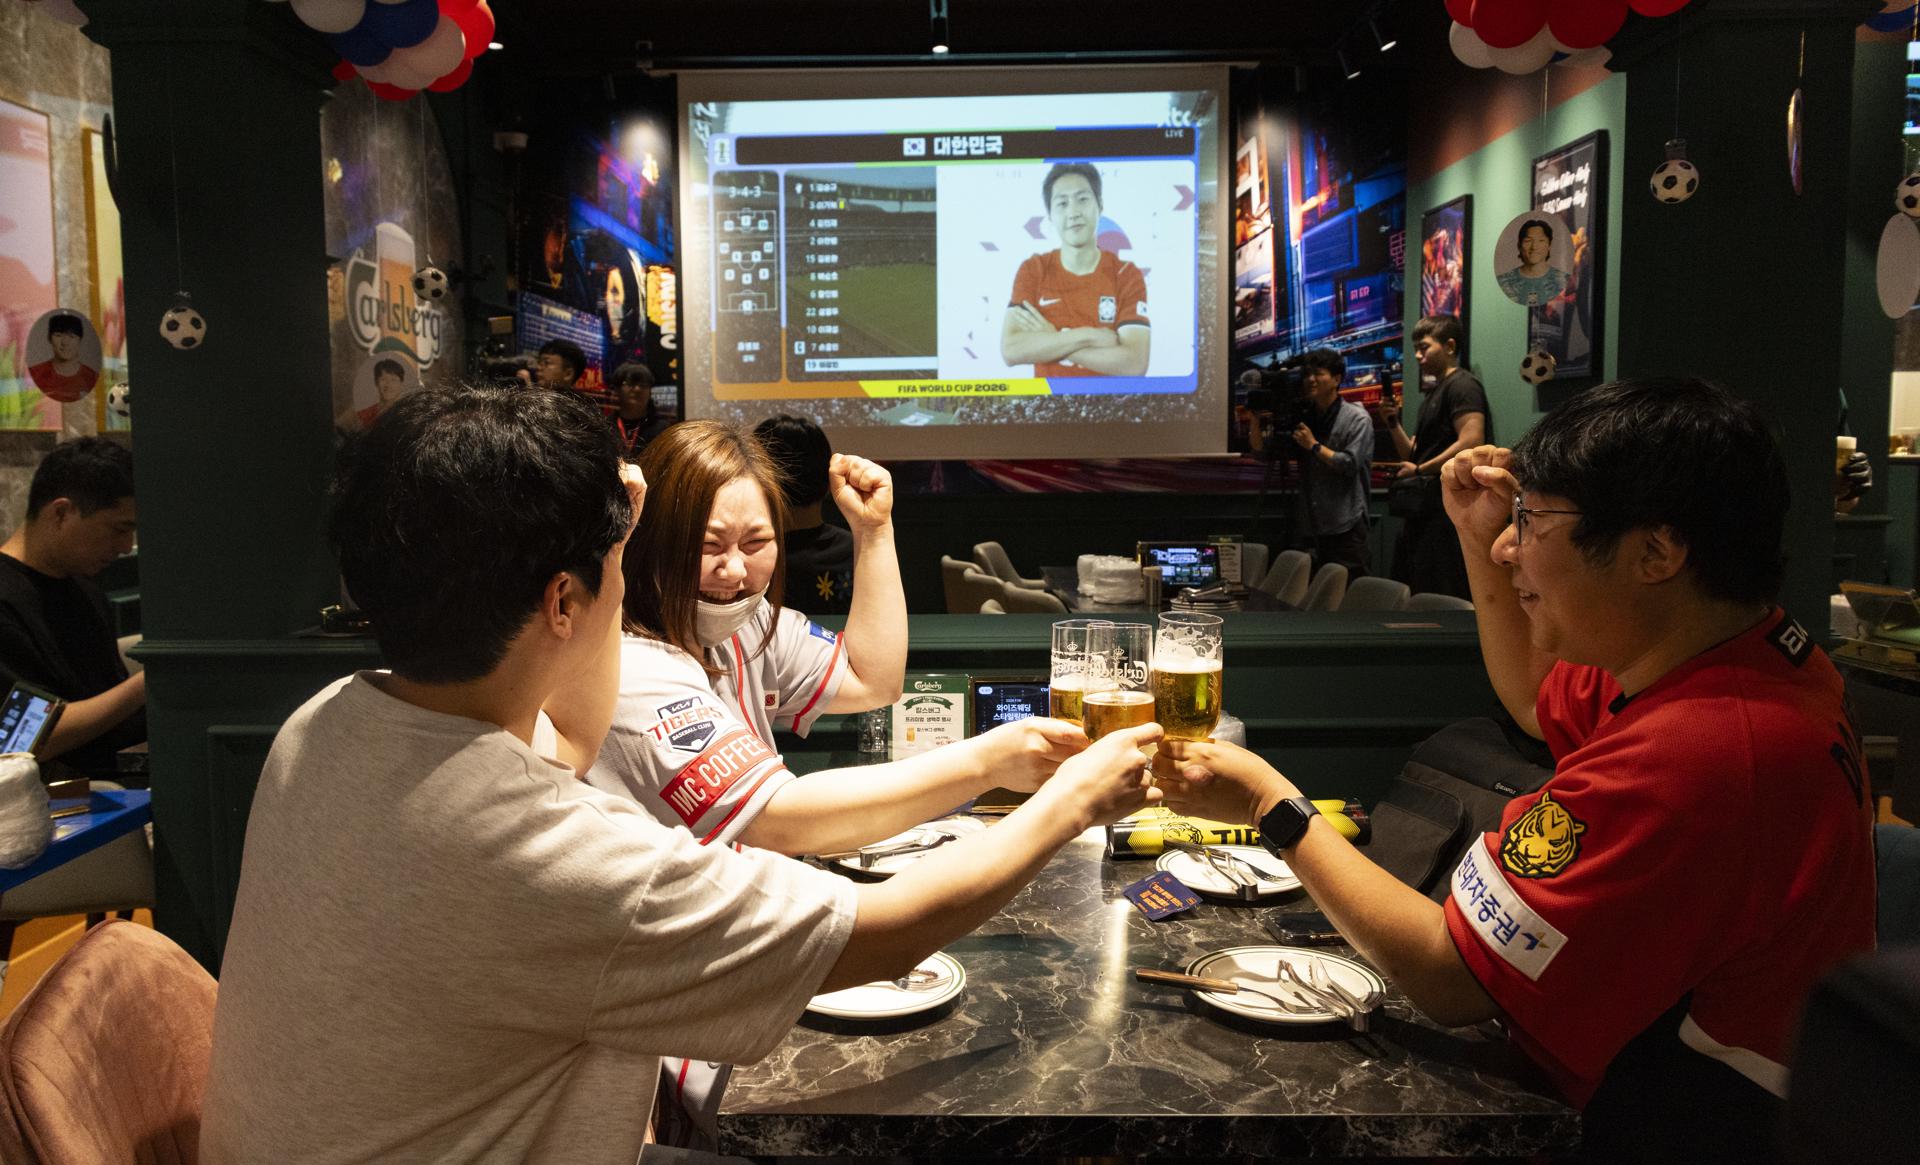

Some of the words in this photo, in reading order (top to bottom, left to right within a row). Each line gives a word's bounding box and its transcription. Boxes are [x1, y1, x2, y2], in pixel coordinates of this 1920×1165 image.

[1165, 128, 1185, 138] LIVE
[933, 136, 1003, 156] 대한민국
[729, 186, 761, 198] 3-4-3
[347, 259, 442, 358] Carlsberg
[898, 384, 918, 394] FIFA
[919, 384, 953, 394] WORLD
[954, 383, 973, 393] CUP
[974, 383, 1008, 392] 2026
[914, 681, 942, 691] Carlsberg
[996, 704, 1031, 712] 와이즈웨딩
[647, 705, 724, 741] TIGERS
[672, 726, 698, 741] BASEBALL
[698, 733, 768, 788] COFFEE
[1210, 828, 1261, 845] TIG
[1457, 851, 1521, 947] 현대차증권
